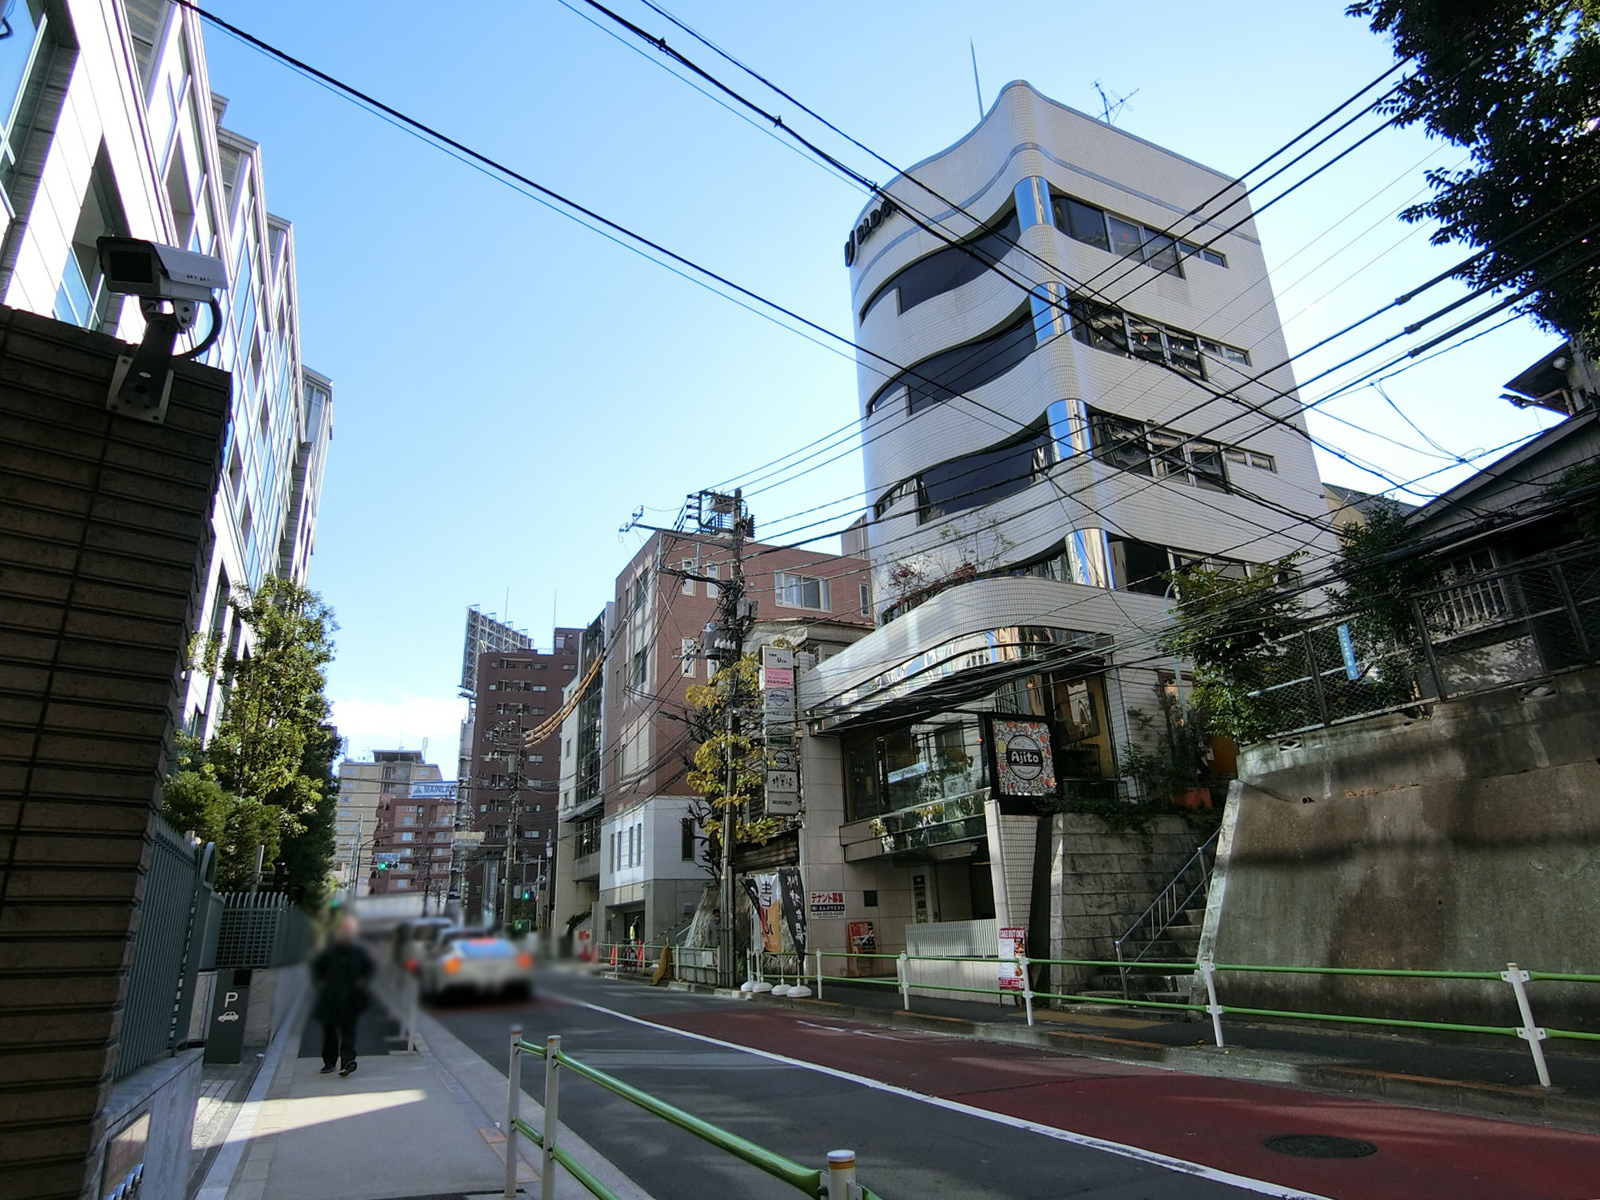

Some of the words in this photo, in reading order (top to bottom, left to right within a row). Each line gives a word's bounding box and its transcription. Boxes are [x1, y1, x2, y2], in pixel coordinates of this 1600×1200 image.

[1011, 751, 1039, 764] Ajito
[811, 892, 844, 904] テナント募集
[225, 992, 238, 1008] P
